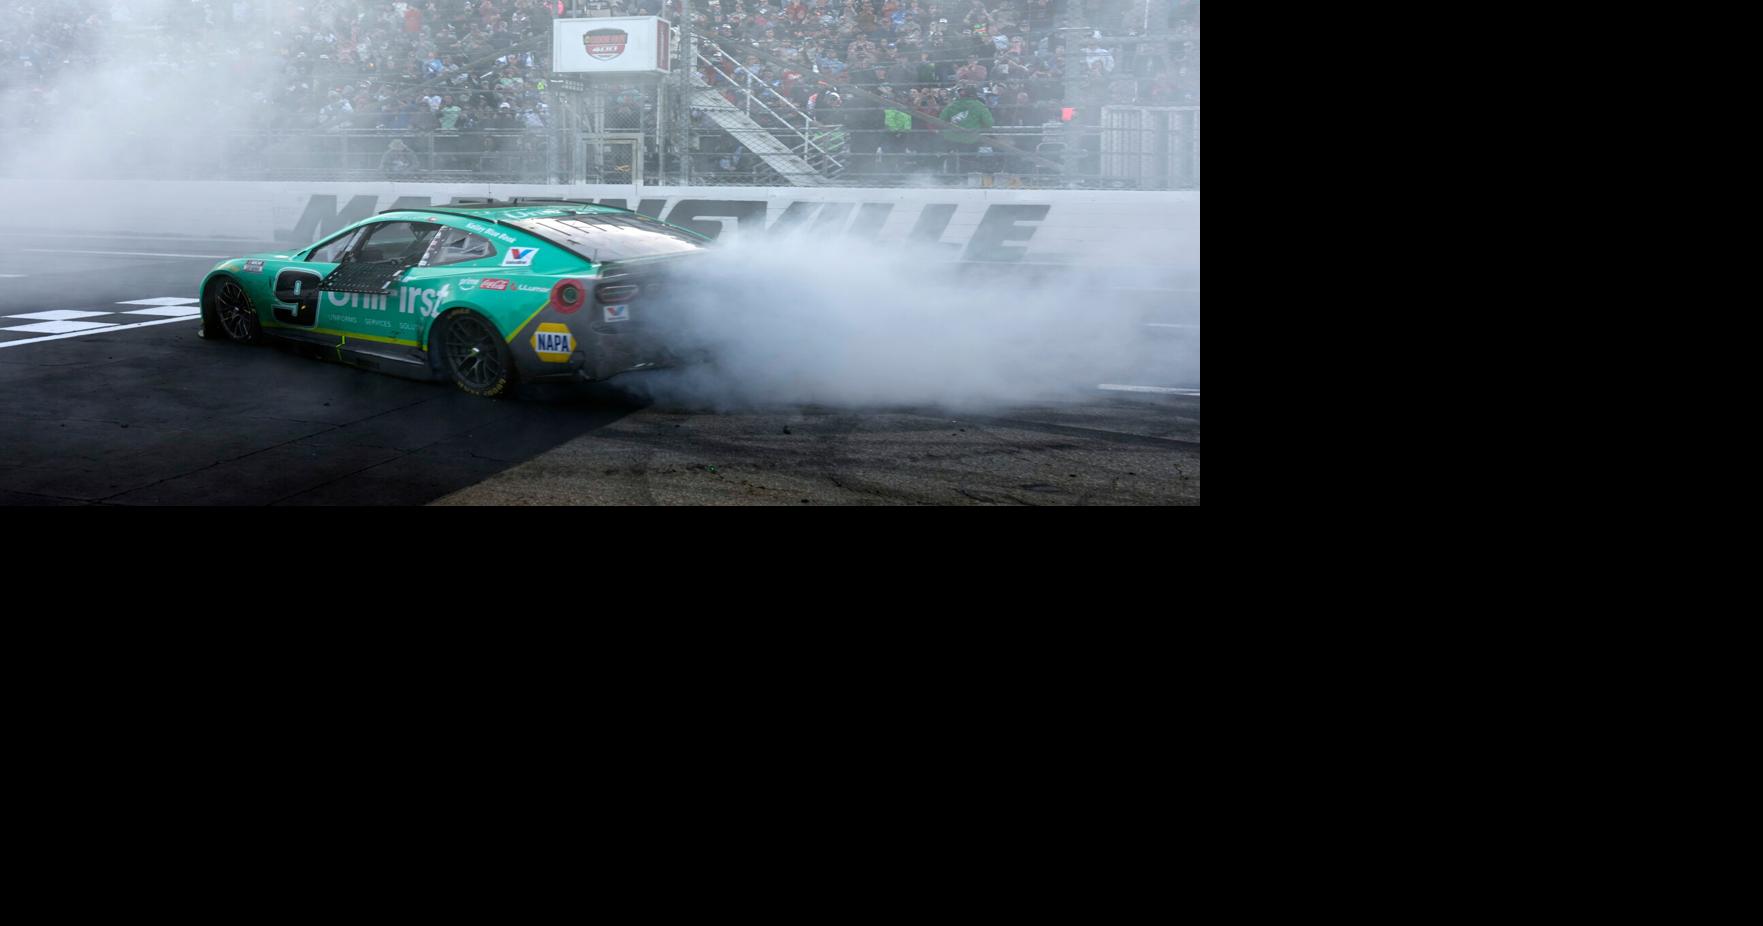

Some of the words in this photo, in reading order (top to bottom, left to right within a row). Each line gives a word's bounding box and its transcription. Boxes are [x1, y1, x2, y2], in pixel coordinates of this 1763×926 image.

[275, 194, 1051, 262] MSVILLE
[271, 267, 324, 329] 9
[537, 333, 570, 353] NAPA
